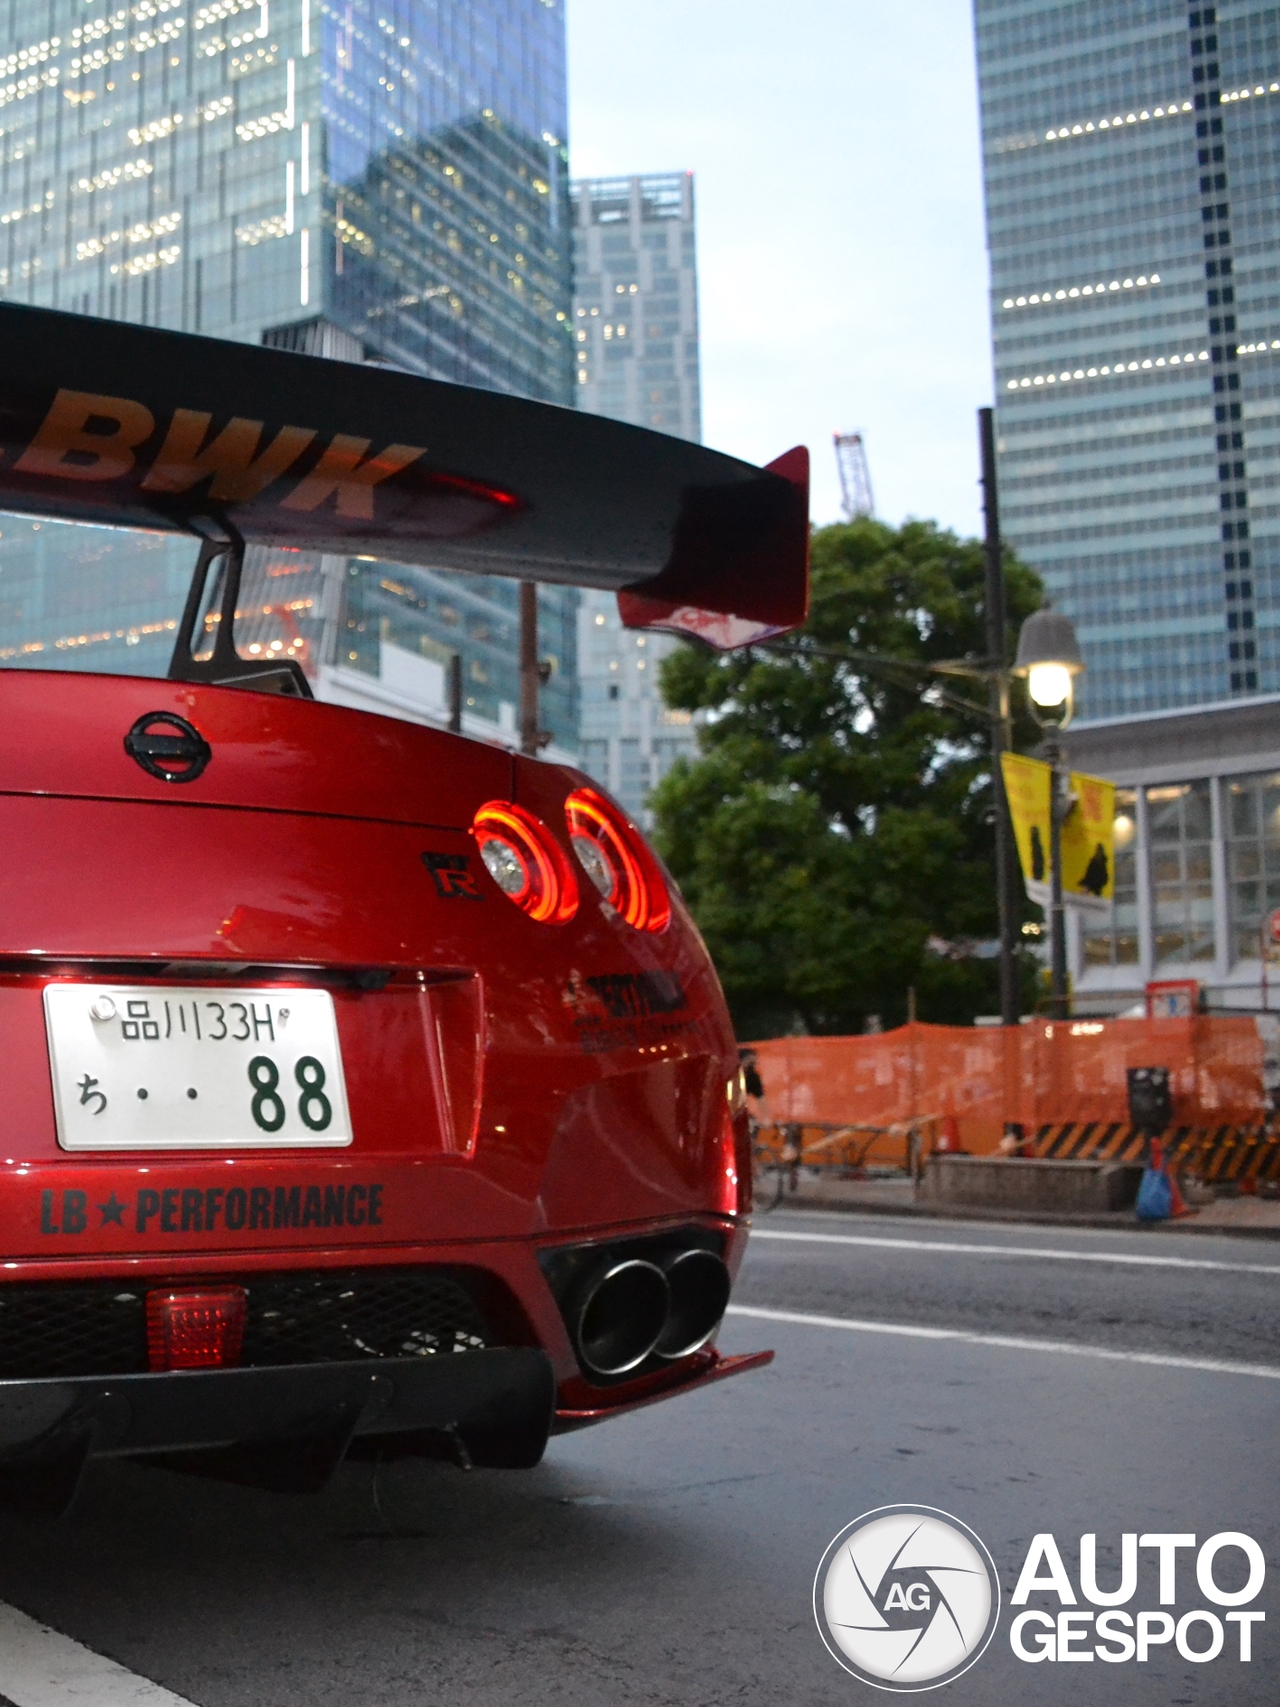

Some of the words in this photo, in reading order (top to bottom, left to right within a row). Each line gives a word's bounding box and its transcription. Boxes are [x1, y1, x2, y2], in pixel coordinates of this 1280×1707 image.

[77, 1073, 108, 1116] ち
[248, 1055, 333, 1133] 88
[40, 1189, 87, 1235] LB
[135, 1183, 385, 1234] PERFORMANCE
